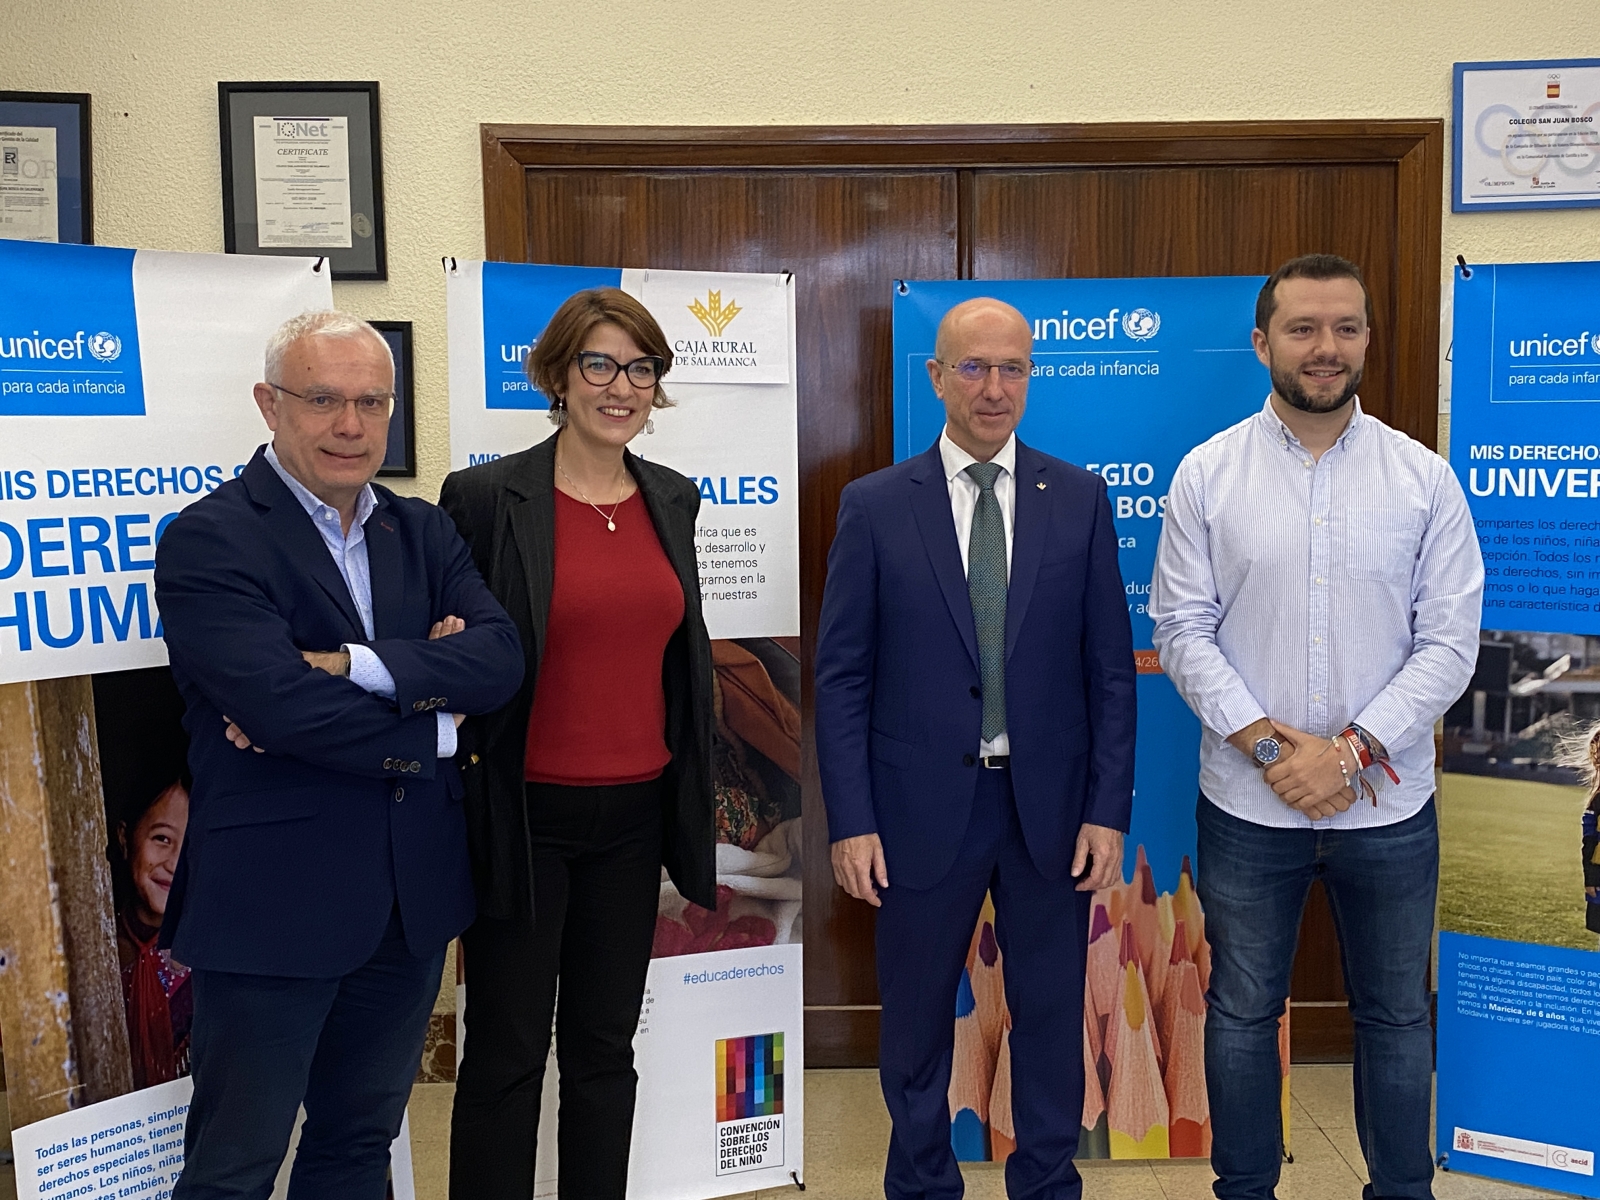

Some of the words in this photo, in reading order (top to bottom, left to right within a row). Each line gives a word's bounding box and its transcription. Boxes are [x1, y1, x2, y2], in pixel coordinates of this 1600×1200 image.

[1509, 117, 1537, 125] COLEGIO
[277, 122, 328, 138] IQNet
[277, 148, 329, 156] CERTIFICATE
[0, 330, 85, 361] unicef
[674, 340, 708, 355] CAJA
[712, 341, 757, 354] RURAL
[1509, 331, 1590, 358] unicef
[675, 356, 689, 366] DE
[691, 357, 757, 368] SALAMANCA
[1059, 361, 1096, 377] cada
[1100, 360, 1160, 376] infancia
[502, 381, 529, 394] para
[1509, 373, 1536, 387] para
[1539, 372, 1570, 385] cada
[2, 381, 33, 396] para
[37, 380, 70, 394] cada
[73, 380, 126, 394] infancia
[1470, 445, 1505, 460] MIS
[1509, 445, 1600, 461] DERECHO
[47, 466, 225, 499] DERECHOS
[688, 476, 780, 506] ALES
[1538, 519, 1556, 531] los
[721, 528, 741, 540] que
[744, 528, 757, 537] es
[1493, 534, 1509, 545] de
[1512, 534, 1530, 546] los
[1533, 535, 1570, 550] niños,
[705, 541, 757, 553] desarrollo
[759, 543, 766, 555] y
[1118, 537, 1136, 548] ca
[1533, 549, 1570, 563] Todos
[1573, 551, 1591, 563] los
[711, 559, 758, 570] tenemos
[740, 575, 754, 584] en
[757, 573, 766, 584] la
[1485, 567, 1500, 577] os
[1503, 566, 1562, 581] derechos,
[1566, 570, 1585, 580] sin
[712, 590, 758, 602] nuestras
[1517, 584, 1525, 593] o
[1528, 582, 1539, 594] lo
[1542, 585, 1567, 597] que
[1484, 598, 1505, 609] una
[1509, 599, 1590, 613] característica
[0, 583, 165, 652] HUM
[1458, 952, 1469, 960] No
[1471, 955, 1499, 966] importa
[1500, 959, 1515, 968] que
[1516, 961, 1546, 972] seamos
[1548, 965, 1579, 976] grandes
[683, 963, 785, 986] #educaderechos
[1457, 962, 1481, 971] chicos
[1489, 966, 1514, 977] chicas,
[1516, 970, 1545, 981] nuestro
[1566, 977, 1586, 986] color
[1587, 979, 1598, 987] de
[1457, 979, 1477, 989] niñas
[1484, 984, 1534, 998] adolescentes
[1535, 991, 1570, 1003] tenemos
[1458, 971, 1490, 982] tenemos
[1491, 976, 1516, 987] alguna
[1517, 980, 1567, 994] discapacidad,
[1570, 987, 1592, 997] todos
[646, 997, 655, 1005] de
[1489, 994, 1527, 1006] educación
[1535, 1000, 1542, 1008] la
[1581, 1007, 1592, 1015] En
[1457, 998, 1481, 1009] vemos
[1488, 1003, 1525, 1016] Maricica,
[1526, 1009, 1537, 1017] de
[1545, 1012, 1567, 1022] años,
[1569, 1016, 1585, 1025] que
[1457, 1006, 1489, 1019] Moldavia
[1496, 1014, 1520, 1025] quiere
[1521, 1018, 1534, 1026] ser
[1535, 1020, 1569, 1032] jugadora
[1569, 1025, 1581, 1033] de
[719, 1117, 781, 1138] CONVENCIÓN
[35, 1142, 69, 1160] Todas
[72, 1135, 88, 1149] las
[91, 1118, 145, 1145] personas,
[719, 1135, 751, 1148] SOBRE
[752, 1132, 770, 1143] LOS
[37, 1163, 54, 1178] ser
[57, 1153, 88, 1170] seres
[90, 1134, 147, 1159] humanos,
[148, 1122, 184, 1140] tienen
[719, 1143, 768, 1159] DERECHOS
[719, 1158, 738, 1170] DEL
[738, 1153, 763, 1167] NIÑO
[1570, 1157, 1588, 1167] aecid
[38, 1167, 90, 1194] derechos
[93, 1148, 151, 1174] especiales
[41, 1183, 97, 1200] umanos.
[99, 1176, 119, 1190] Los
[122, 1164, 156, 1182] niños,
[119, 1175, 168, 1199] también,
